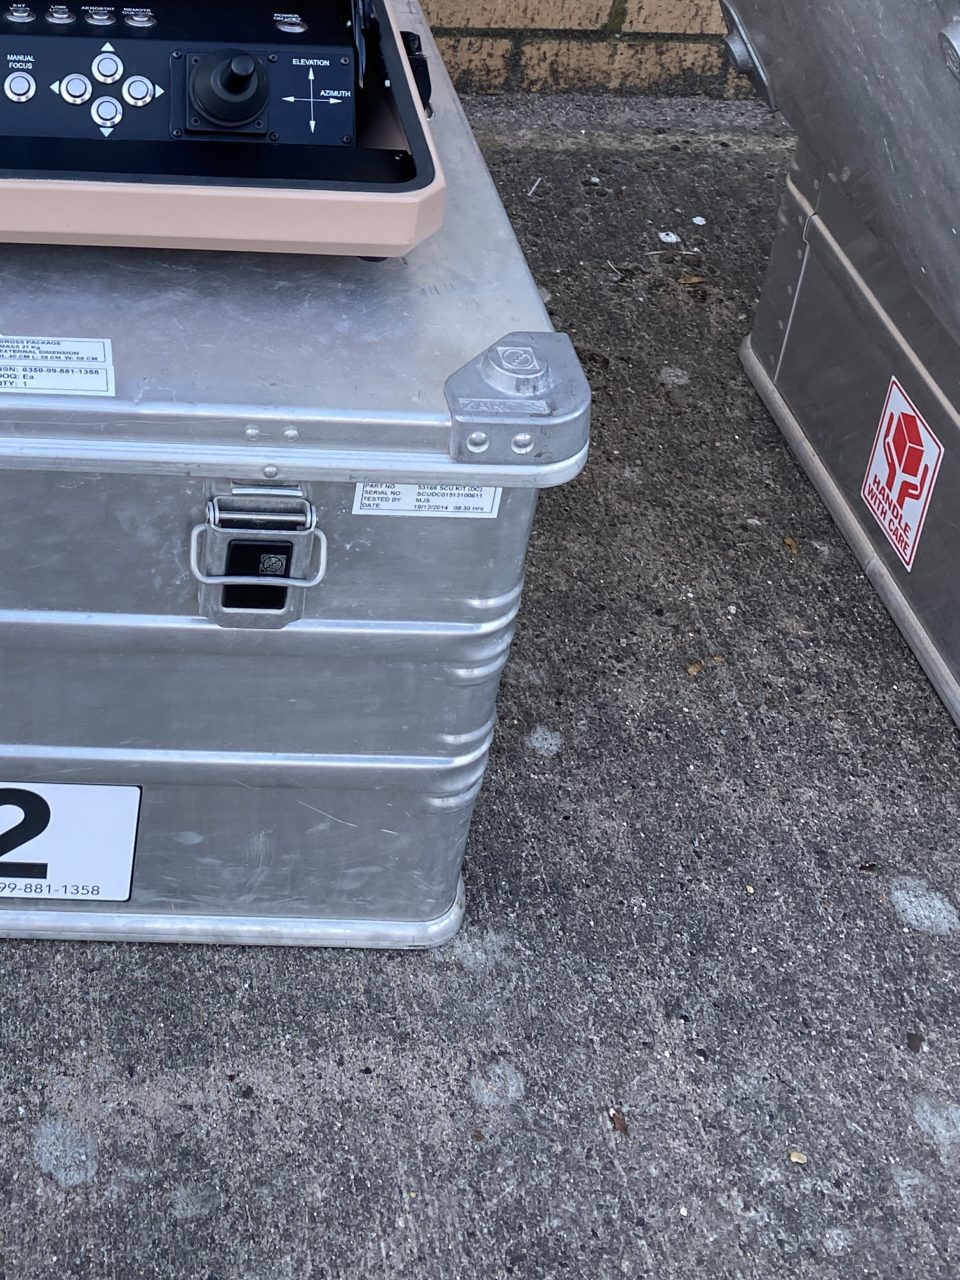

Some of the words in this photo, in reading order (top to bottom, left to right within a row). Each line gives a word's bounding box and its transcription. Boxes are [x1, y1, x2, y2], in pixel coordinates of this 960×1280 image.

[6, 54, 36, 62] MANUAL
[292, 58, 330, 67] ELEVATION
[8, 61, 33, 70] FOCUS
[319, 89, 351, 97] AZIMUTH
[872, 474, 911, 540] HANDLE
[867, 483, 887, 521] WITH
[888, 518, 910, 557] CARE
